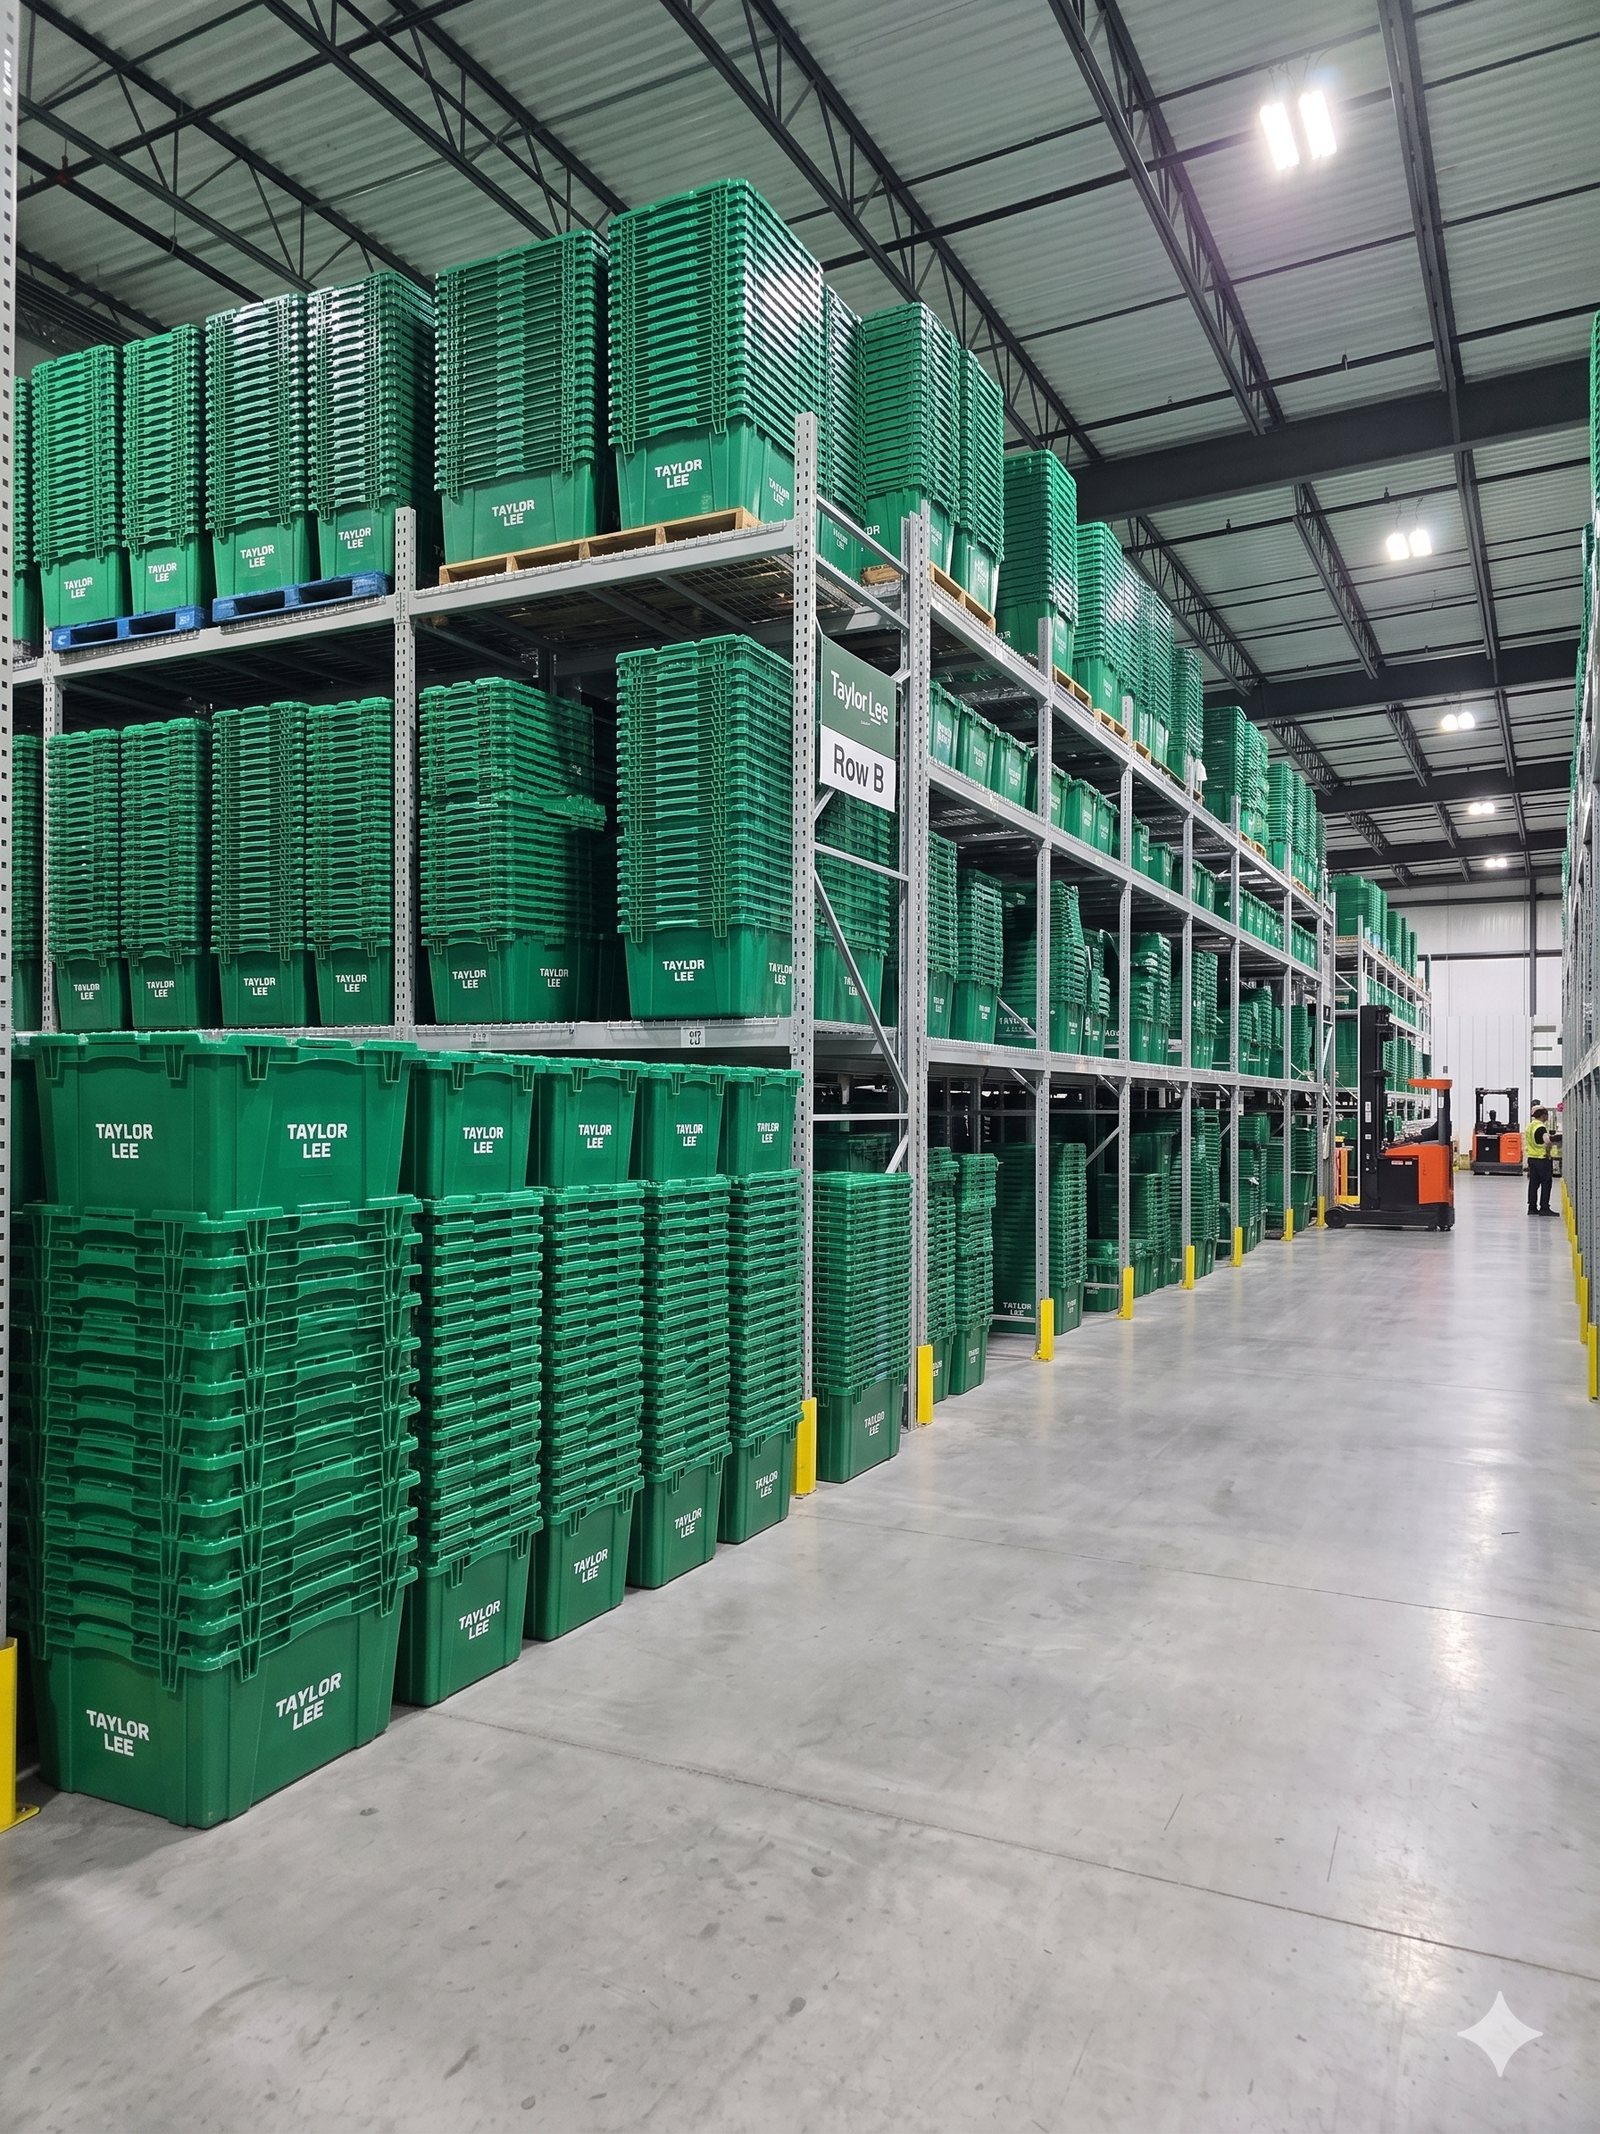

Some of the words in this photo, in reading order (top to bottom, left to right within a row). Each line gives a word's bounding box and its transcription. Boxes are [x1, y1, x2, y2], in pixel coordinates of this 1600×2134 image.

[655, 459, 702, 477] TAYLOR
[667, 473, 689, 488] LEE
[492, 500, 535, 517] TAYLOR
[504, 513, 524, 526] LEE
[338, 527, 371, 540] TAYLOR
[347, 538, 363, 549] LEE
[240, 545, 274, 559] TAYLOR
[148, 562, 177, 574] TAYLOR
[249, 556, 265, 568] LEE
[155, 572, 169, 582] LEE
[64, 577, 93, 590] TAYLOR
[71, 588, 86, 599] LEE
[831, 669, 868, 710] Taylor
[869, 691, 889, 724] Lee
[834, 743, 869, 787] Row
[874, 762, 884, 793] B
[662, 959, 705, 970] TAYLOR
[335, 974, 367, 983] TAYLOR
[452, 969, 486, 980] TAYLOR
[540, 968, 568, 977] TAYLOR
[674, 971, 694, 981] LEE
[147, 980, 174, 989] TAYLOR
[244, 977, 276, 986] TAYLOR
[462, 979, 478, 989] LEE
[547, 978, 560, 987] LEE
[154, 989, 168, 998] LEE
[252, 987, 268, 996] LEE
[344, 984, 360, 992] LEE
[80, 992, 94, 1000] LEE
[96, 1124, 153, 1139] TAYLOR
[287, 1123, 347, 1139] TAYLOR
[463, 1127, 503, 1139] TAYLOR
[578, 1124, 612, 1135] TAYLOR
[676, 1124, 703, 1134] TAYLOR
[587, 1137, 603, 1148] LEE
[683, 1136, 697, 1146] LEE
[112, 1143, 139, 1159] LEE
[303, 1142, 331, 1158] LEE
[474, 1141, 493, 1154] LEE
[681, 1522, 695, 1538] LEE
[574, 1548, 608, 1575] TAYLOR
[581, 1564, 599, 1583] LEE
[459, 1600, 500, 1629] TAYLOR
[468, 1619, 489, 1640] LEE
[276, 1672, 341, 1717] TAYLOR
[293, 1699, 324, 1730] LEE
[86, 1709, 149, 1741] TAYLOR
[104, 1733, 134, 1757] LEE
